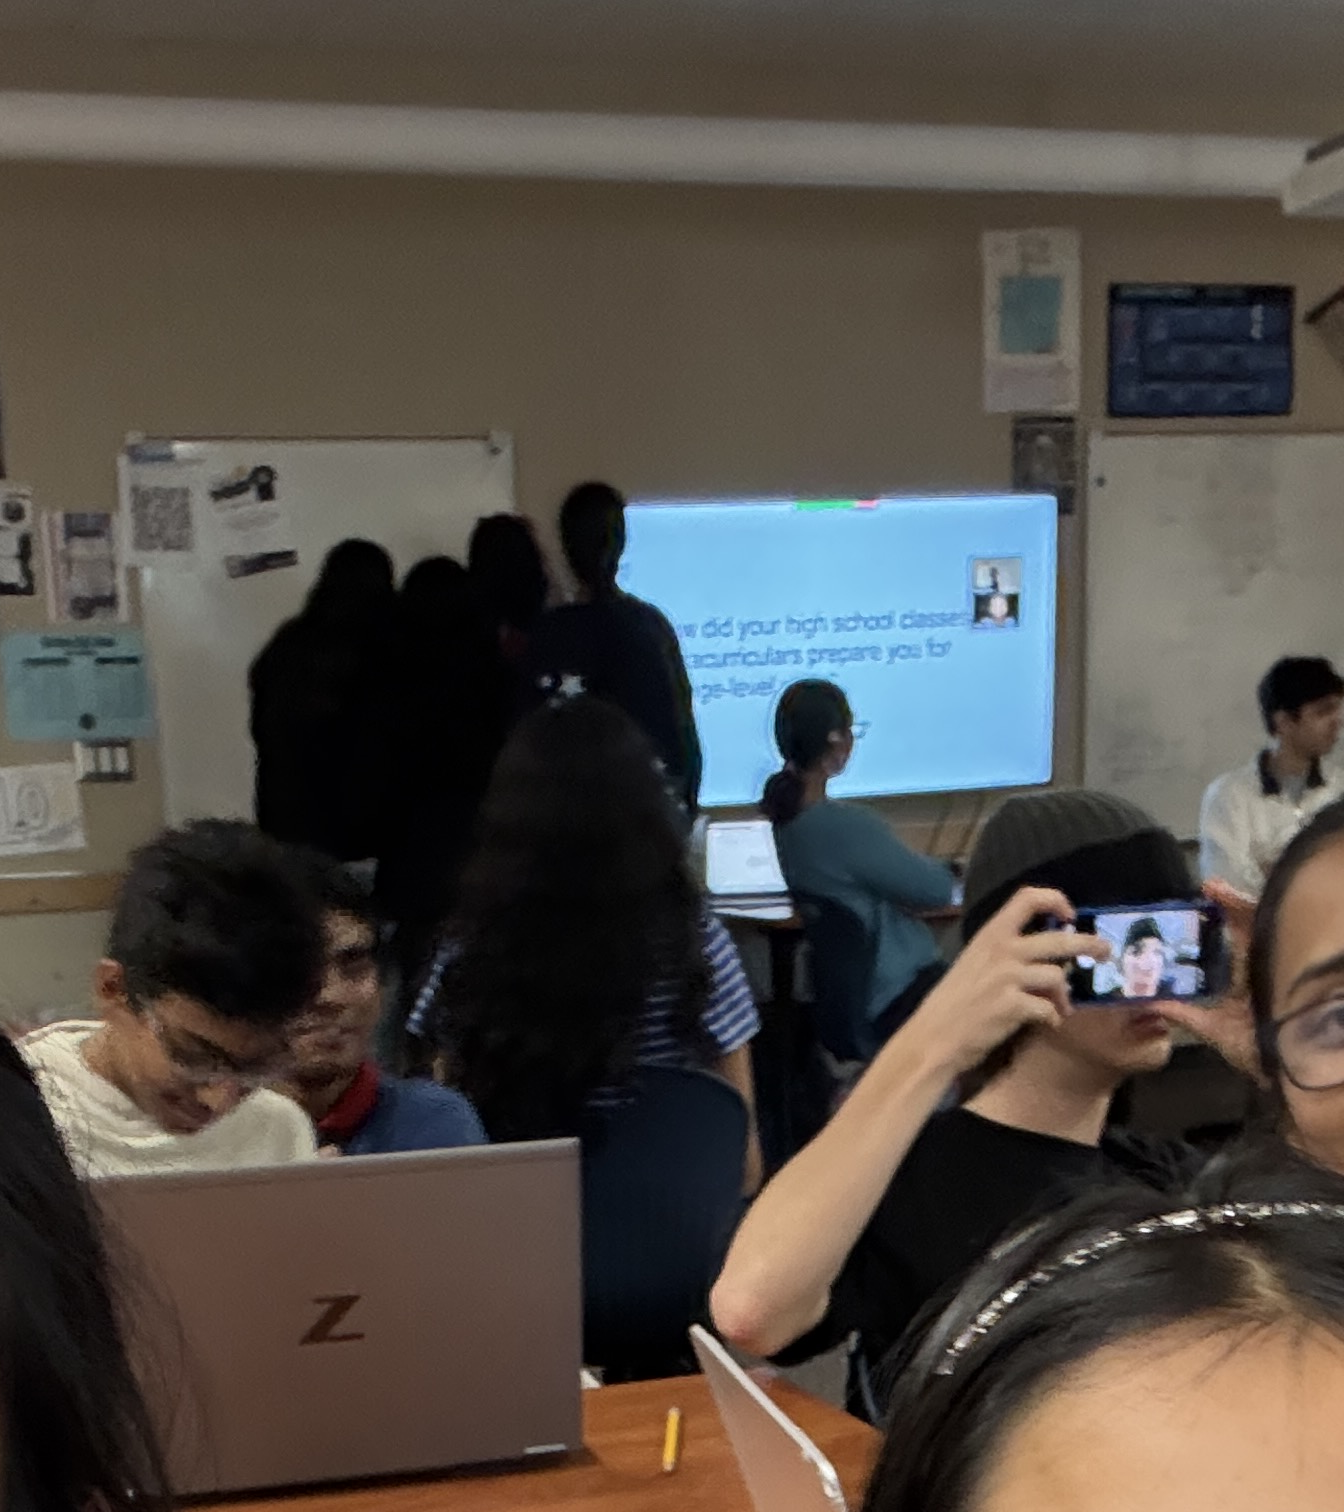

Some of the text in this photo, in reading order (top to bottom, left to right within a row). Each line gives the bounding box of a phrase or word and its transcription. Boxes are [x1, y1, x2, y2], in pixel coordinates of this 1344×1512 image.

[738, 619, 781, 641] your
[832, 610, 895, 633] school
[299, 1294, 365, 1346] Z
